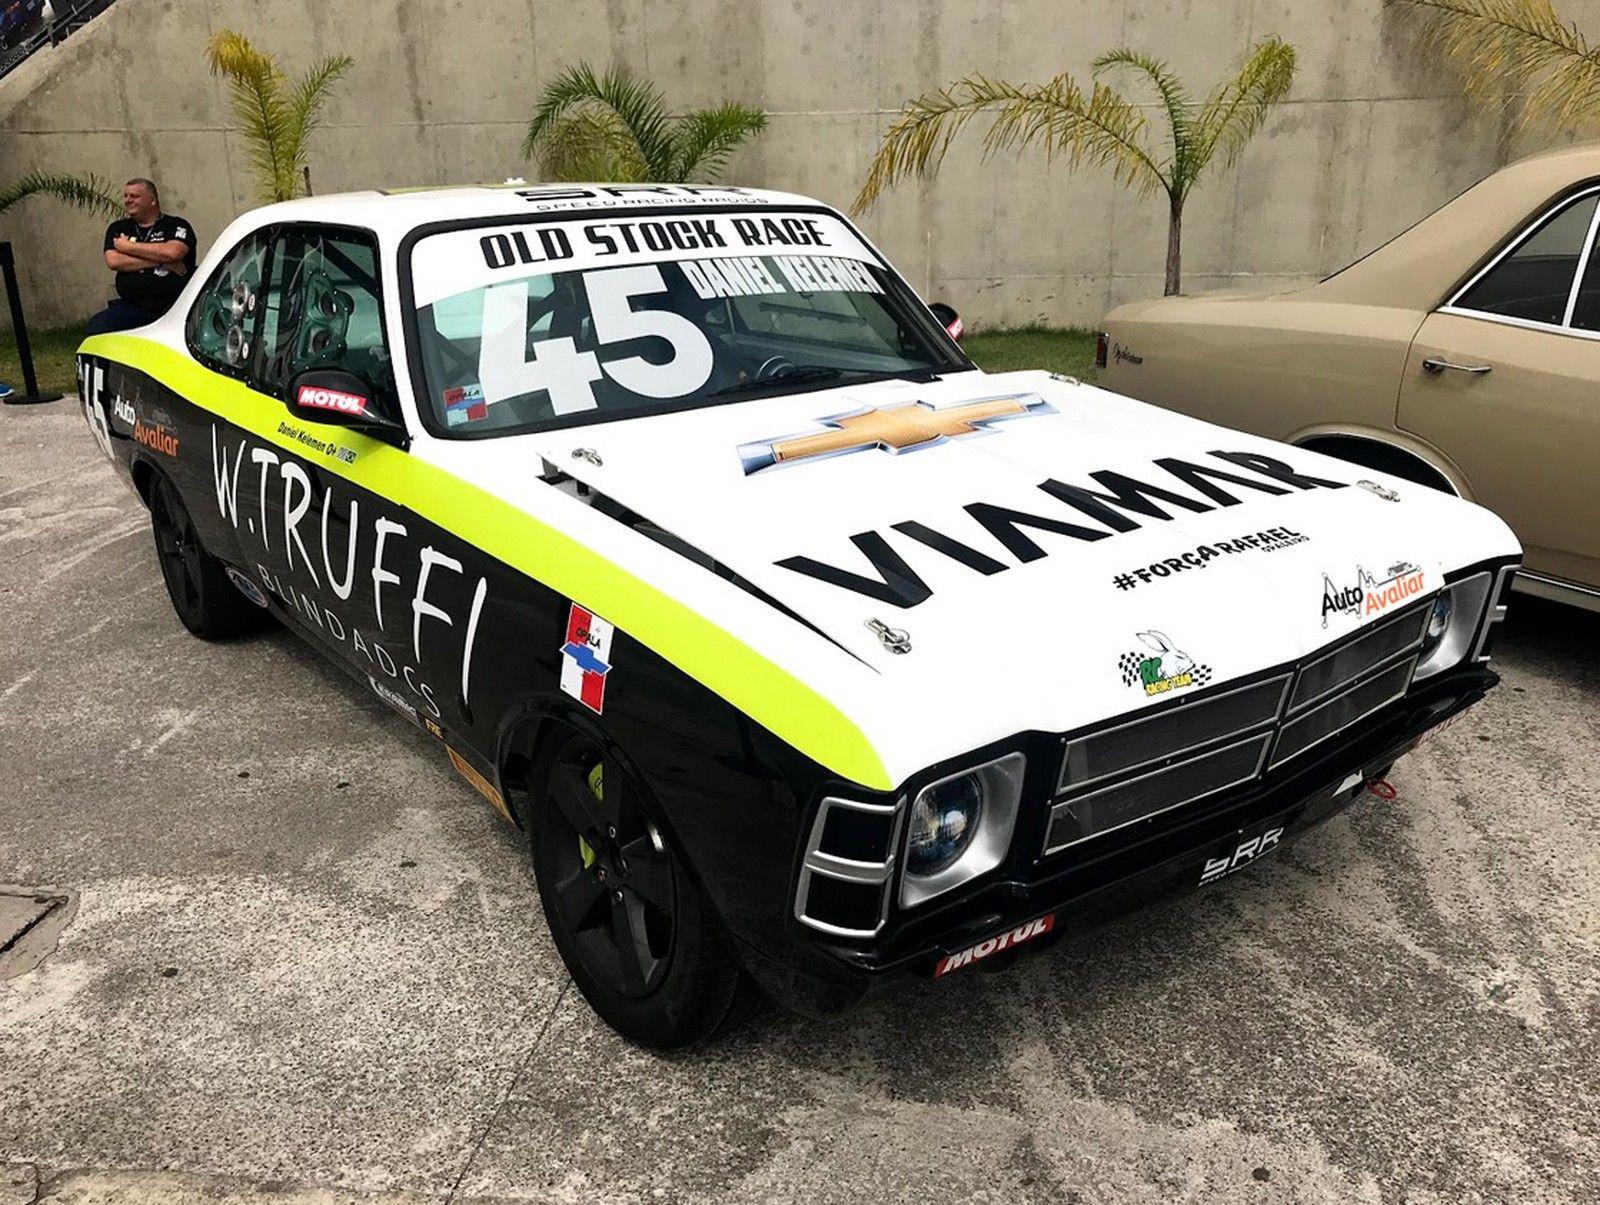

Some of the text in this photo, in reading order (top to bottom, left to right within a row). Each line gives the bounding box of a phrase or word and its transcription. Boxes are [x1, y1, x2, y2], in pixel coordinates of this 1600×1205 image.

[536, 199, 617, 211] SPEED
[480, 218, 832, 269] OLD STOCK RACE
[677, 254, 887, 300] DANIEL KELEMEN
[477, 265, 714, 416] 45
[114, 394, 136, 426] Auto
[300, 389, 361, 412] MOTUL
[134, 418, 179, 458] Avaliar
[772, 449, 1351, 610] VIAMAR
[211, 421, 488, 706] W.TRUFFI
[1321, 571, 1425, 617] Auto Avaliar
[576, 626, 602, 650] OPALA
[1200, 827, 1285, 880] SRR
[941, 918, 1047, 975] MOTUL
